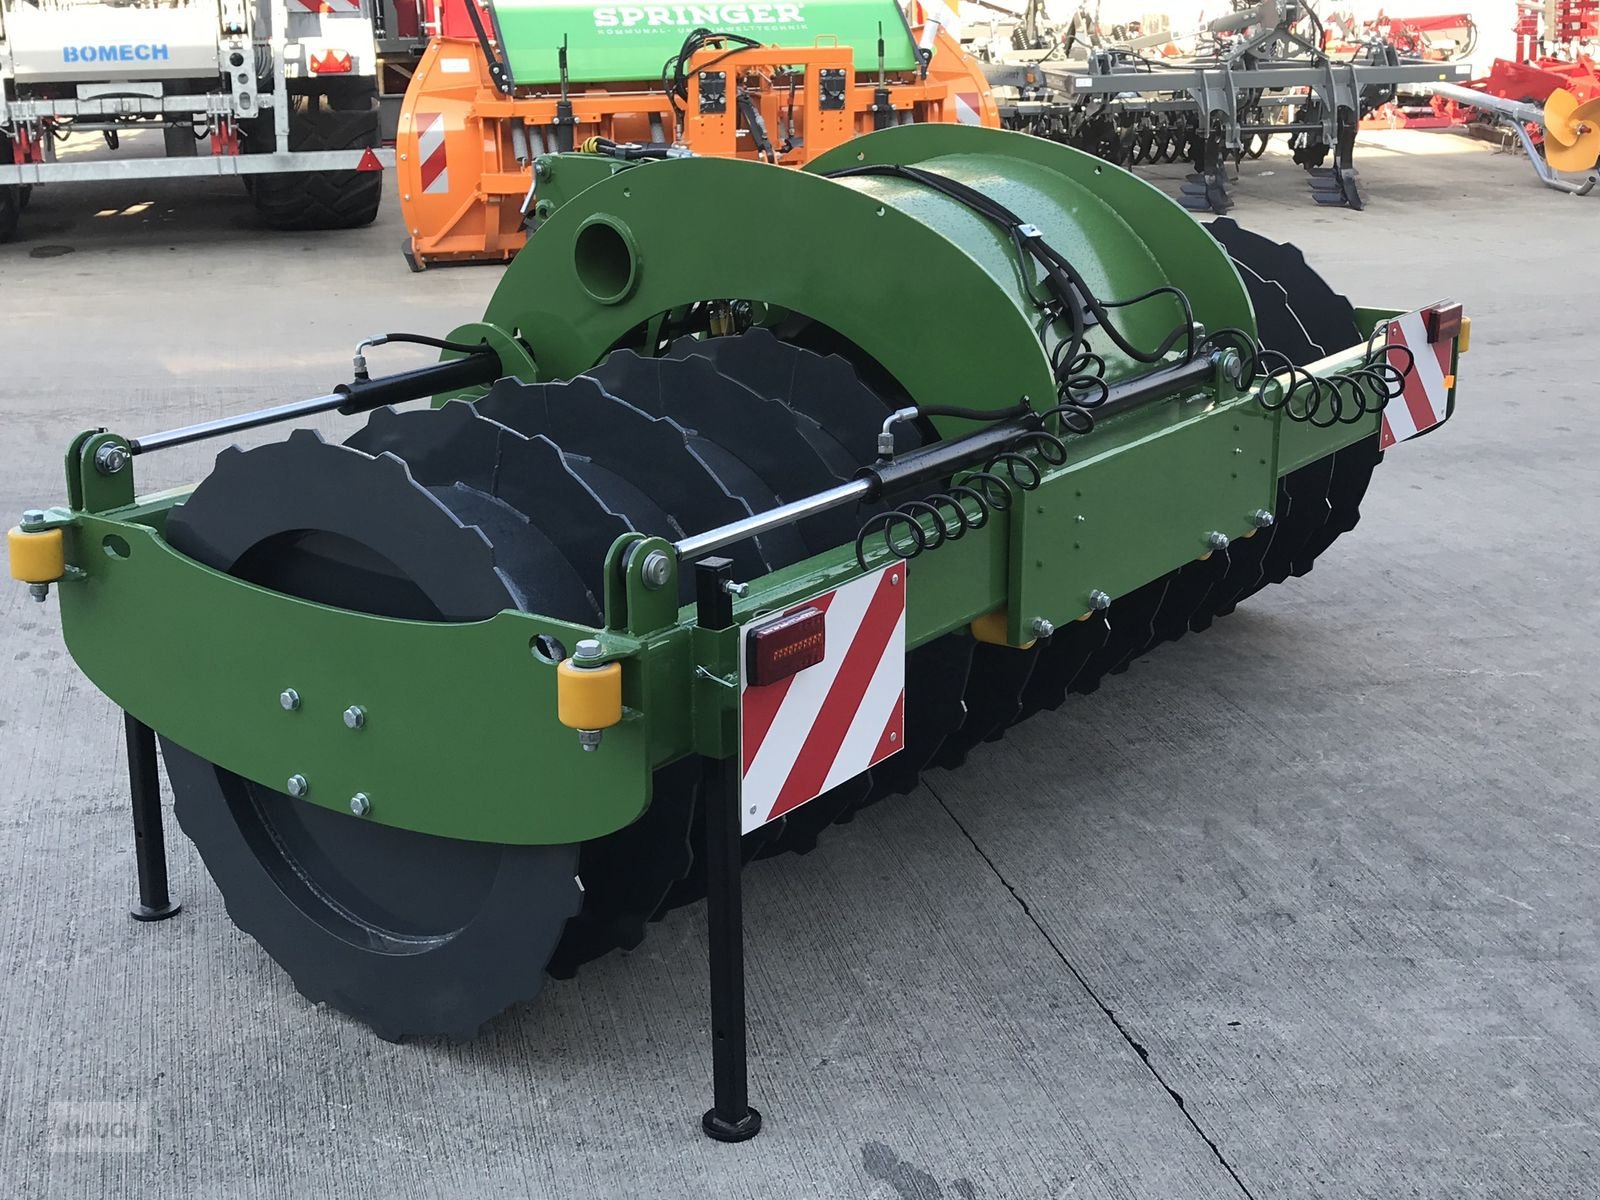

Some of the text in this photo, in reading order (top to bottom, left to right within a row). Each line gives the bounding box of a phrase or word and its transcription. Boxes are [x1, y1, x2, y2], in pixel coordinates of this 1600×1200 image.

[593, 4, 806, 27] SPRINGER
[597, 27, 672, 35] KOMMUNAL-
[63, 44, 169, 63] BOMECH
